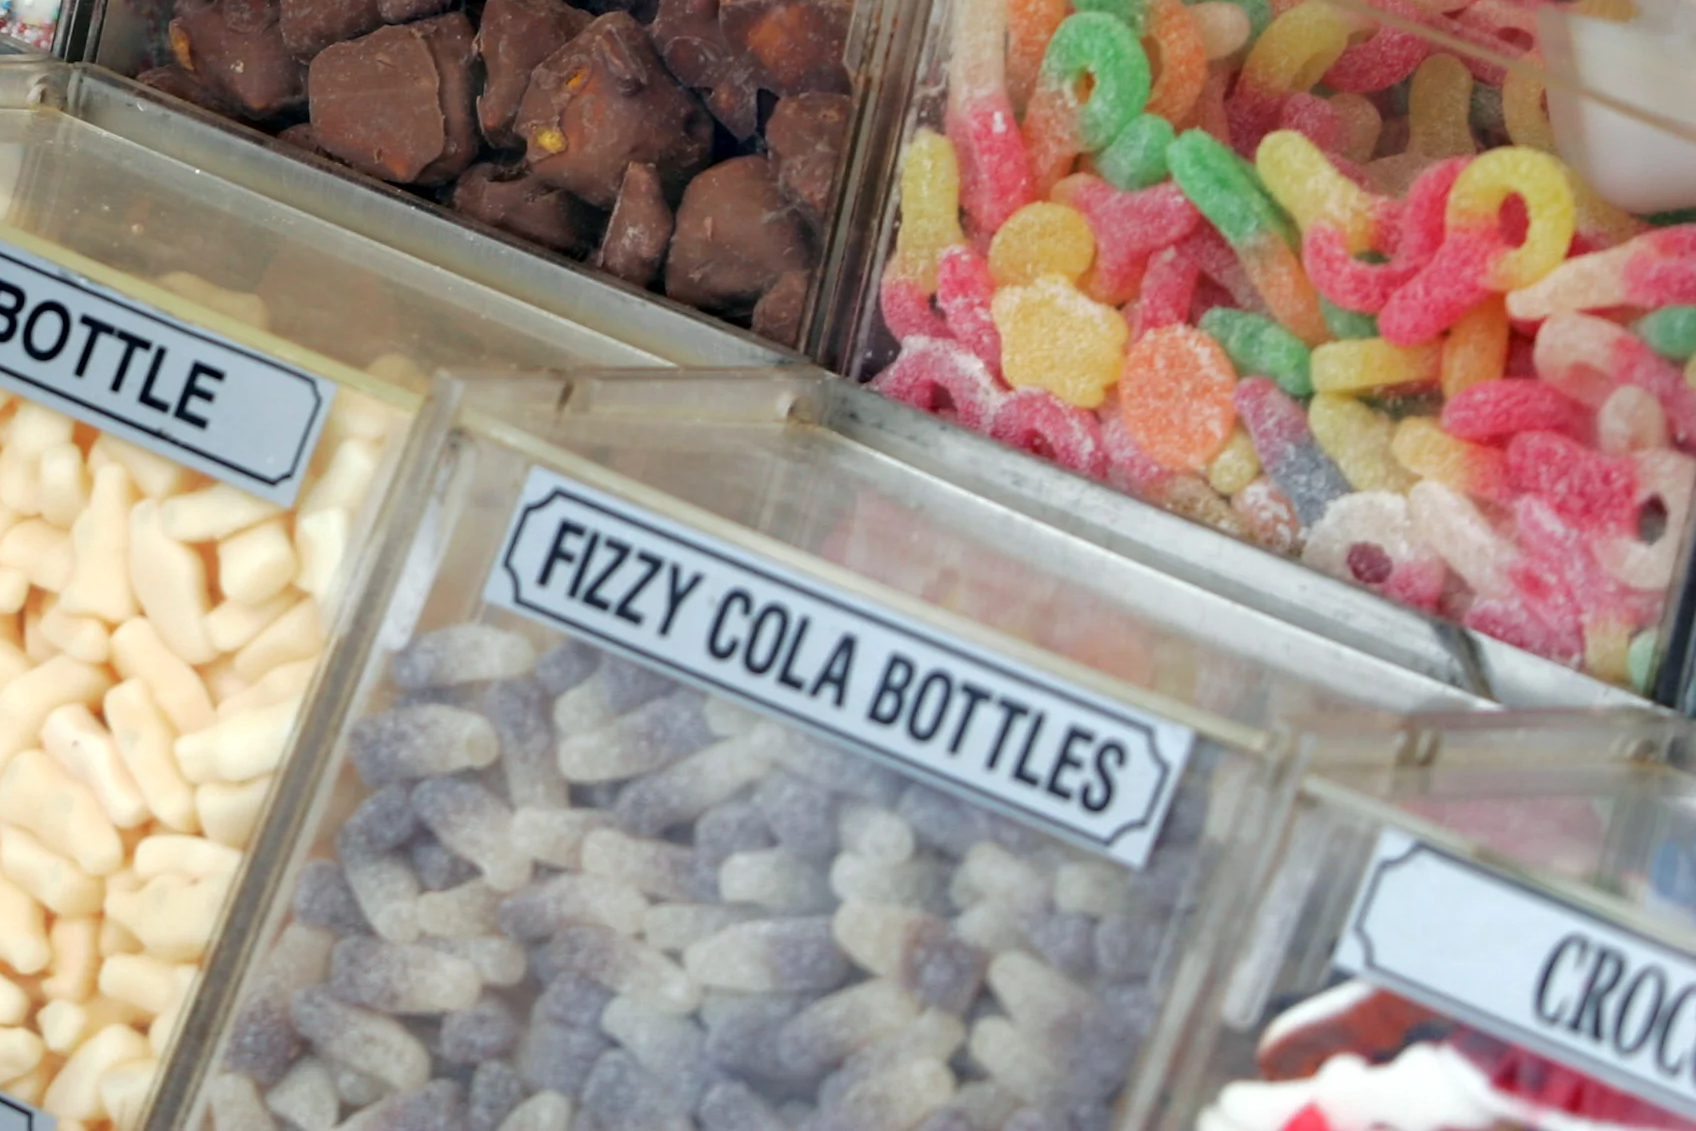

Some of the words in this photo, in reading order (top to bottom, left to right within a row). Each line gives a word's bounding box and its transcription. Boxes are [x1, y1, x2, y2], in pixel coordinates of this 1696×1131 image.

[535, 519, 706, 638] FIZZY
[706, 588, 859, 709] COLA
[867, 654, 1127, 815] BOTTLES
[1533, 932, 1696, 1090] CROC
